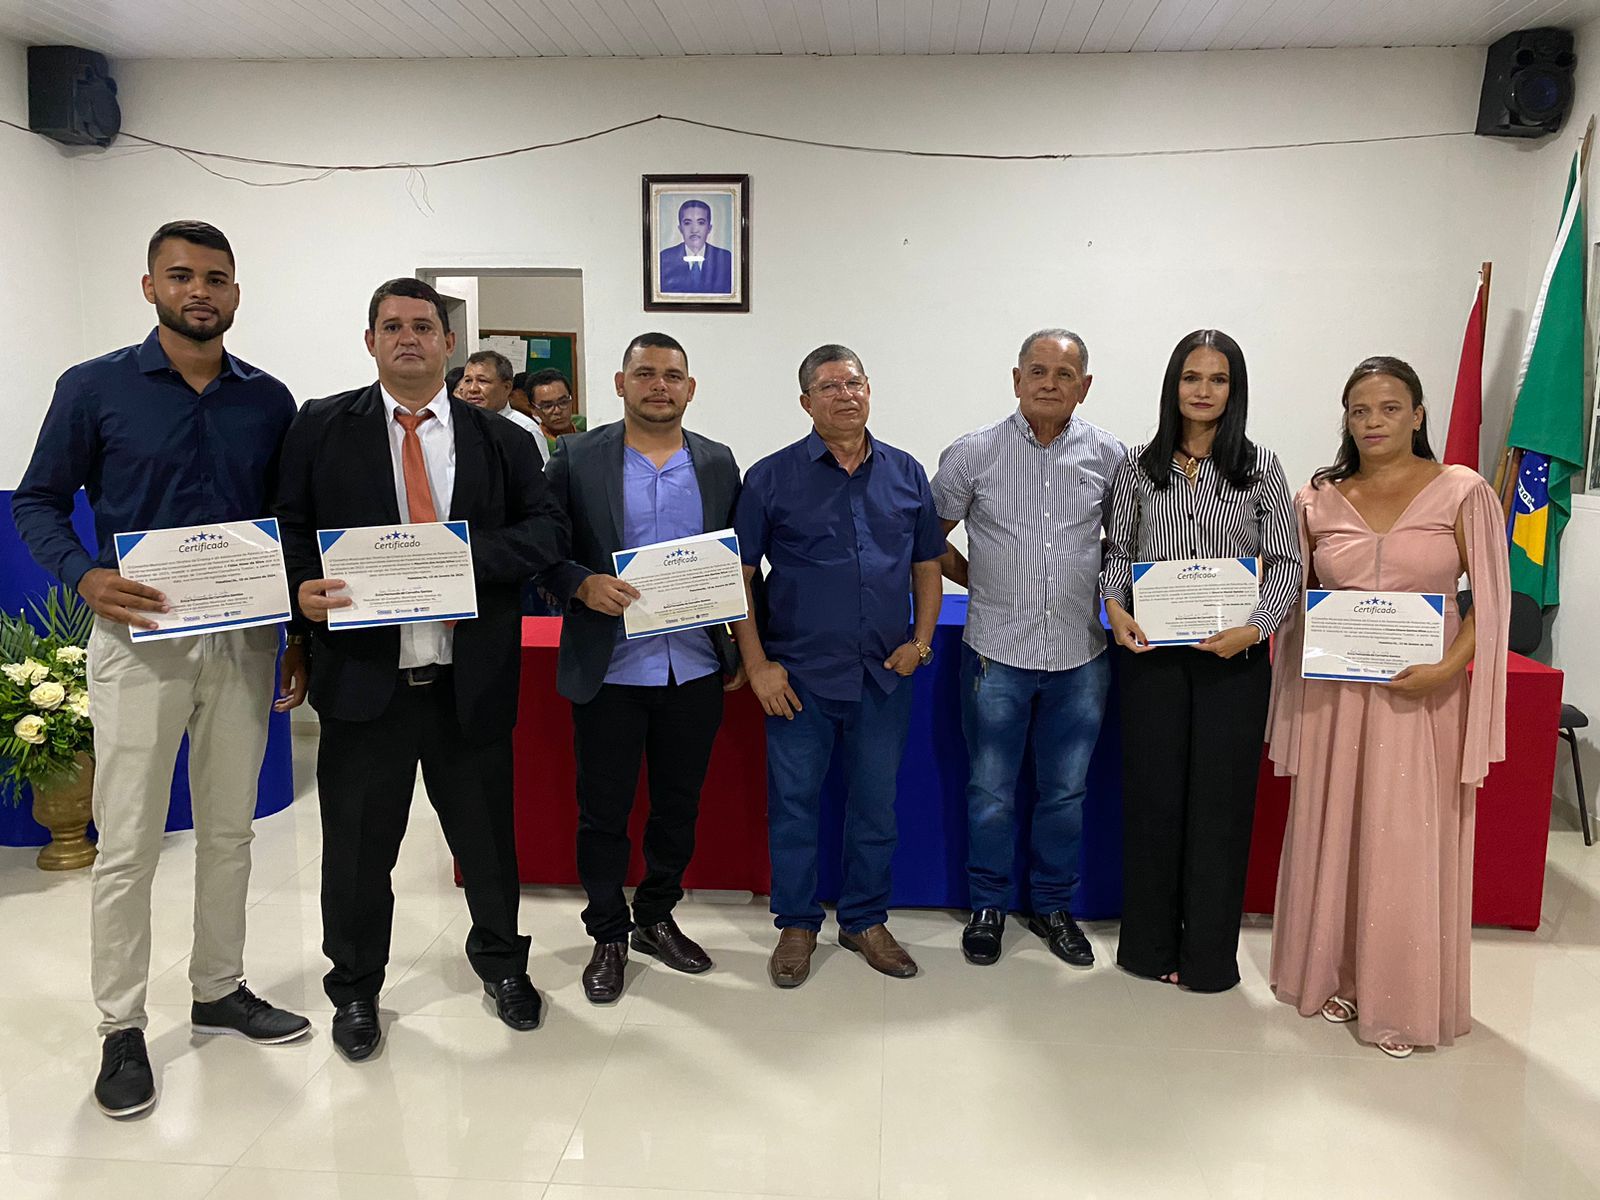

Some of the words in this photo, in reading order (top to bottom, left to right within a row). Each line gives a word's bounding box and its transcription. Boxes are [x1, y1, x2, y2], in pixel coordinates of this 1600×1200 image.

[178, 540, 229, 553] Certificado
[374, 540, 421, 551] Certificado
[663, 555, 698, 567] Certificado
[1353, 605, 1397, 615] Certificado
